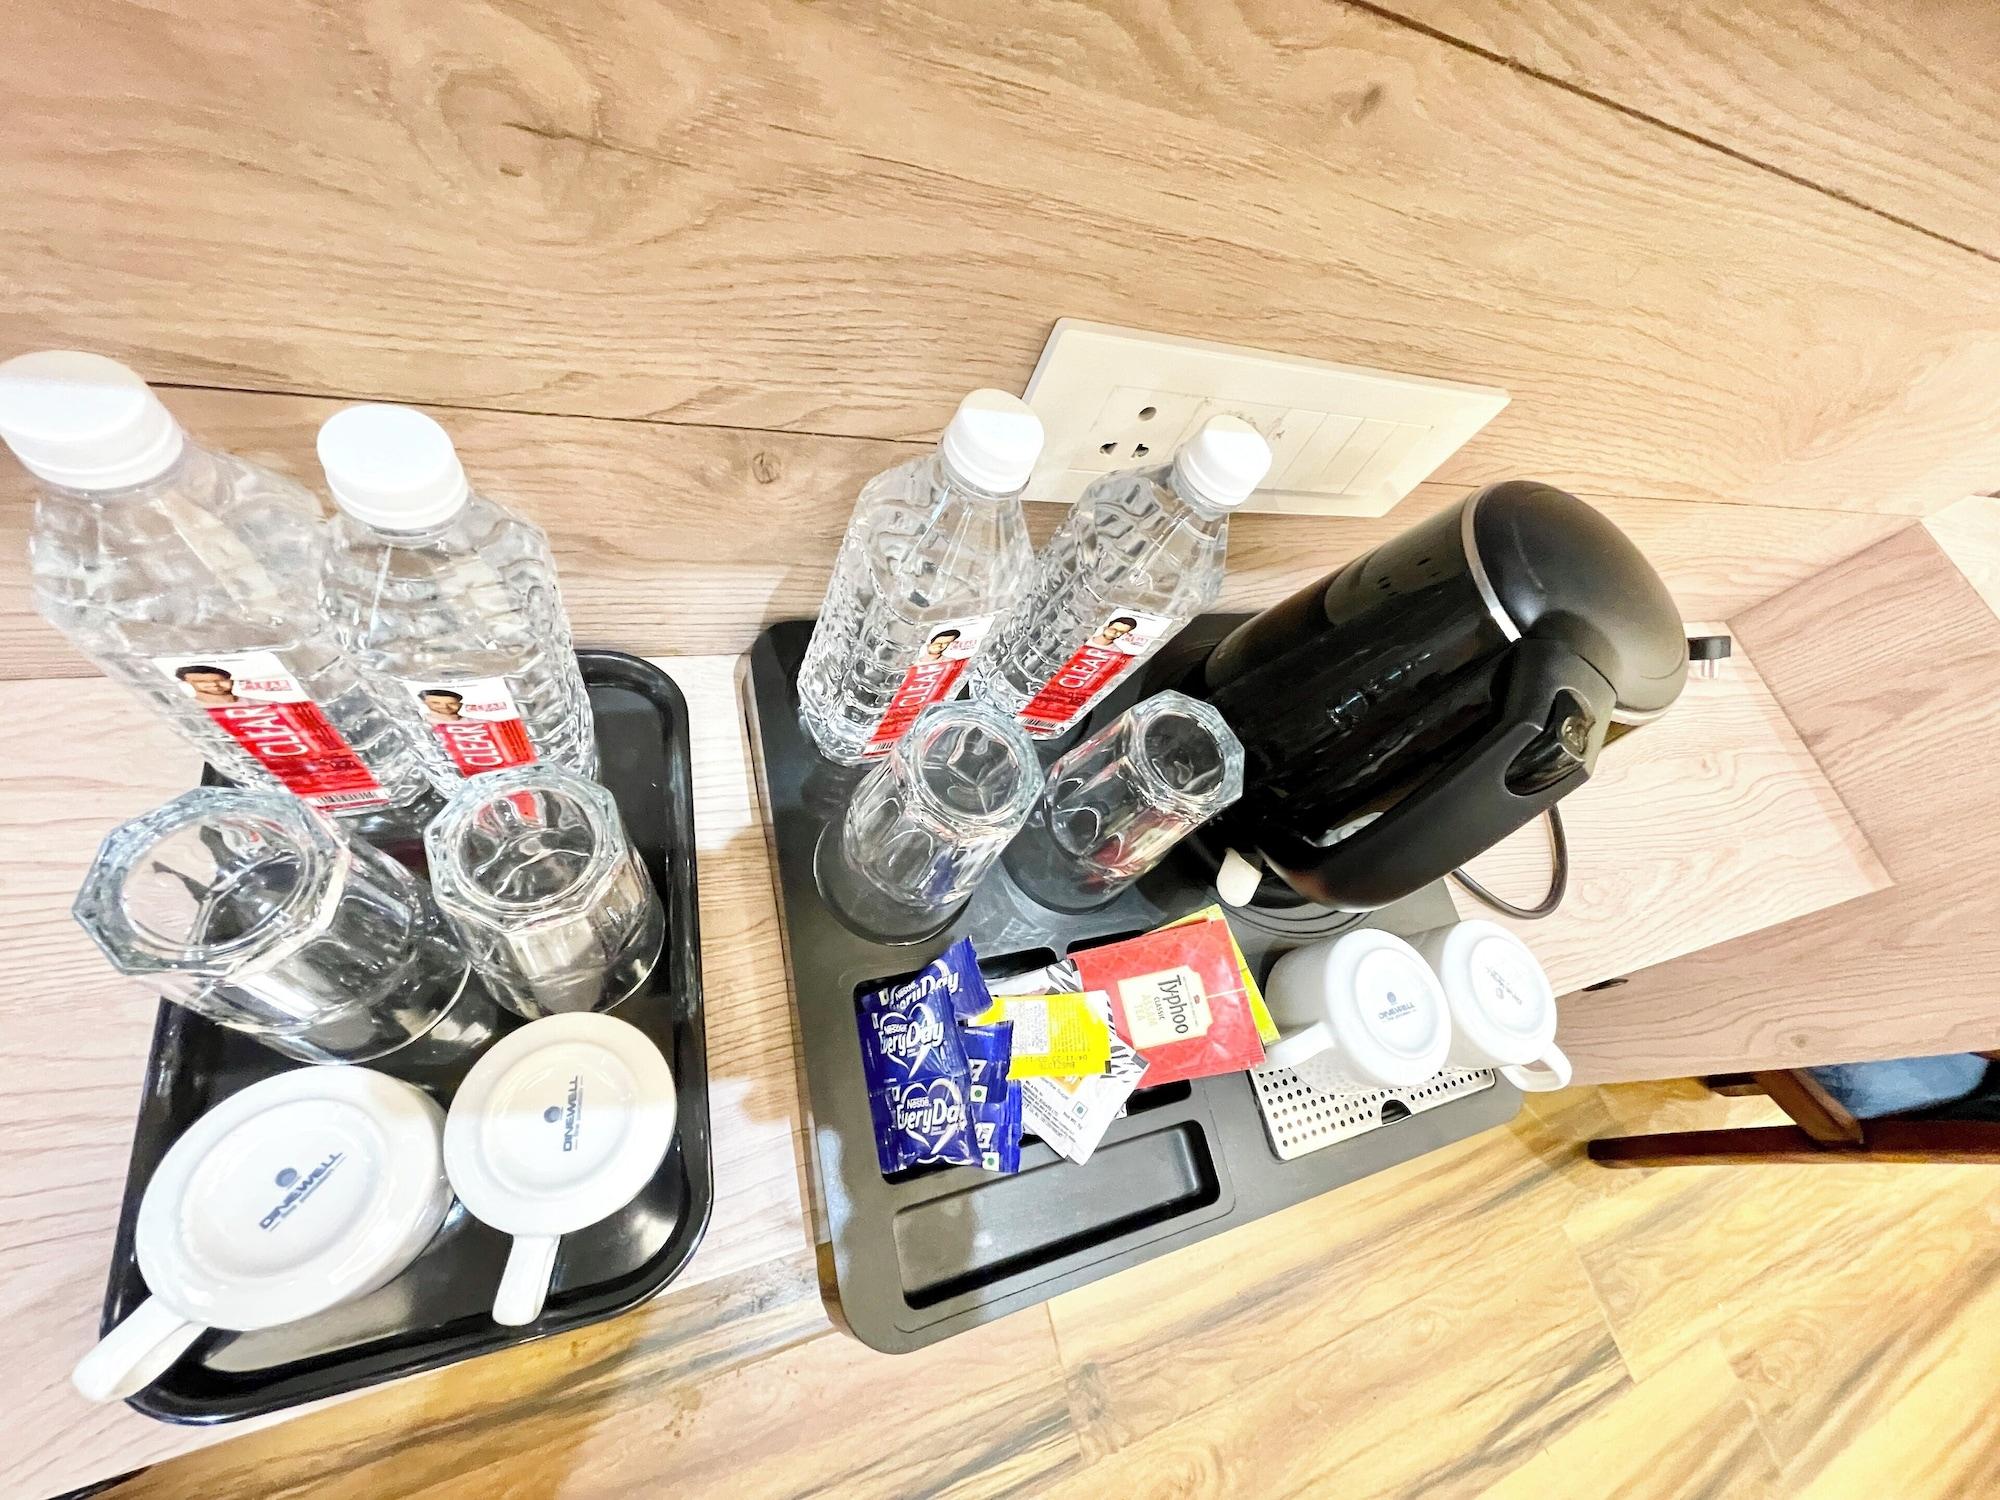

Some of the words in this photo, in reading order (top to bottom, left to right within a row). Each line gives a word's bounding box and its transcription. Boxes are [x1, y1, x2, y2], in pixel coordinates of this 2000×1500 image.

[898, 662, 949, 707] CLEAR
[1058, 648, 1111, 689] CLEAR
[223, 704, 310, 758] CLEAR
[445, 722, 505, 767] CLEAR
[1153, 996, 1166, 1020] CLASSIC
[878, 1021, 944, 1056] EveryDay
[563, 1075, 578, 1152] DINEWELL
[259, 1152, 343, 1230] DINEWELL
